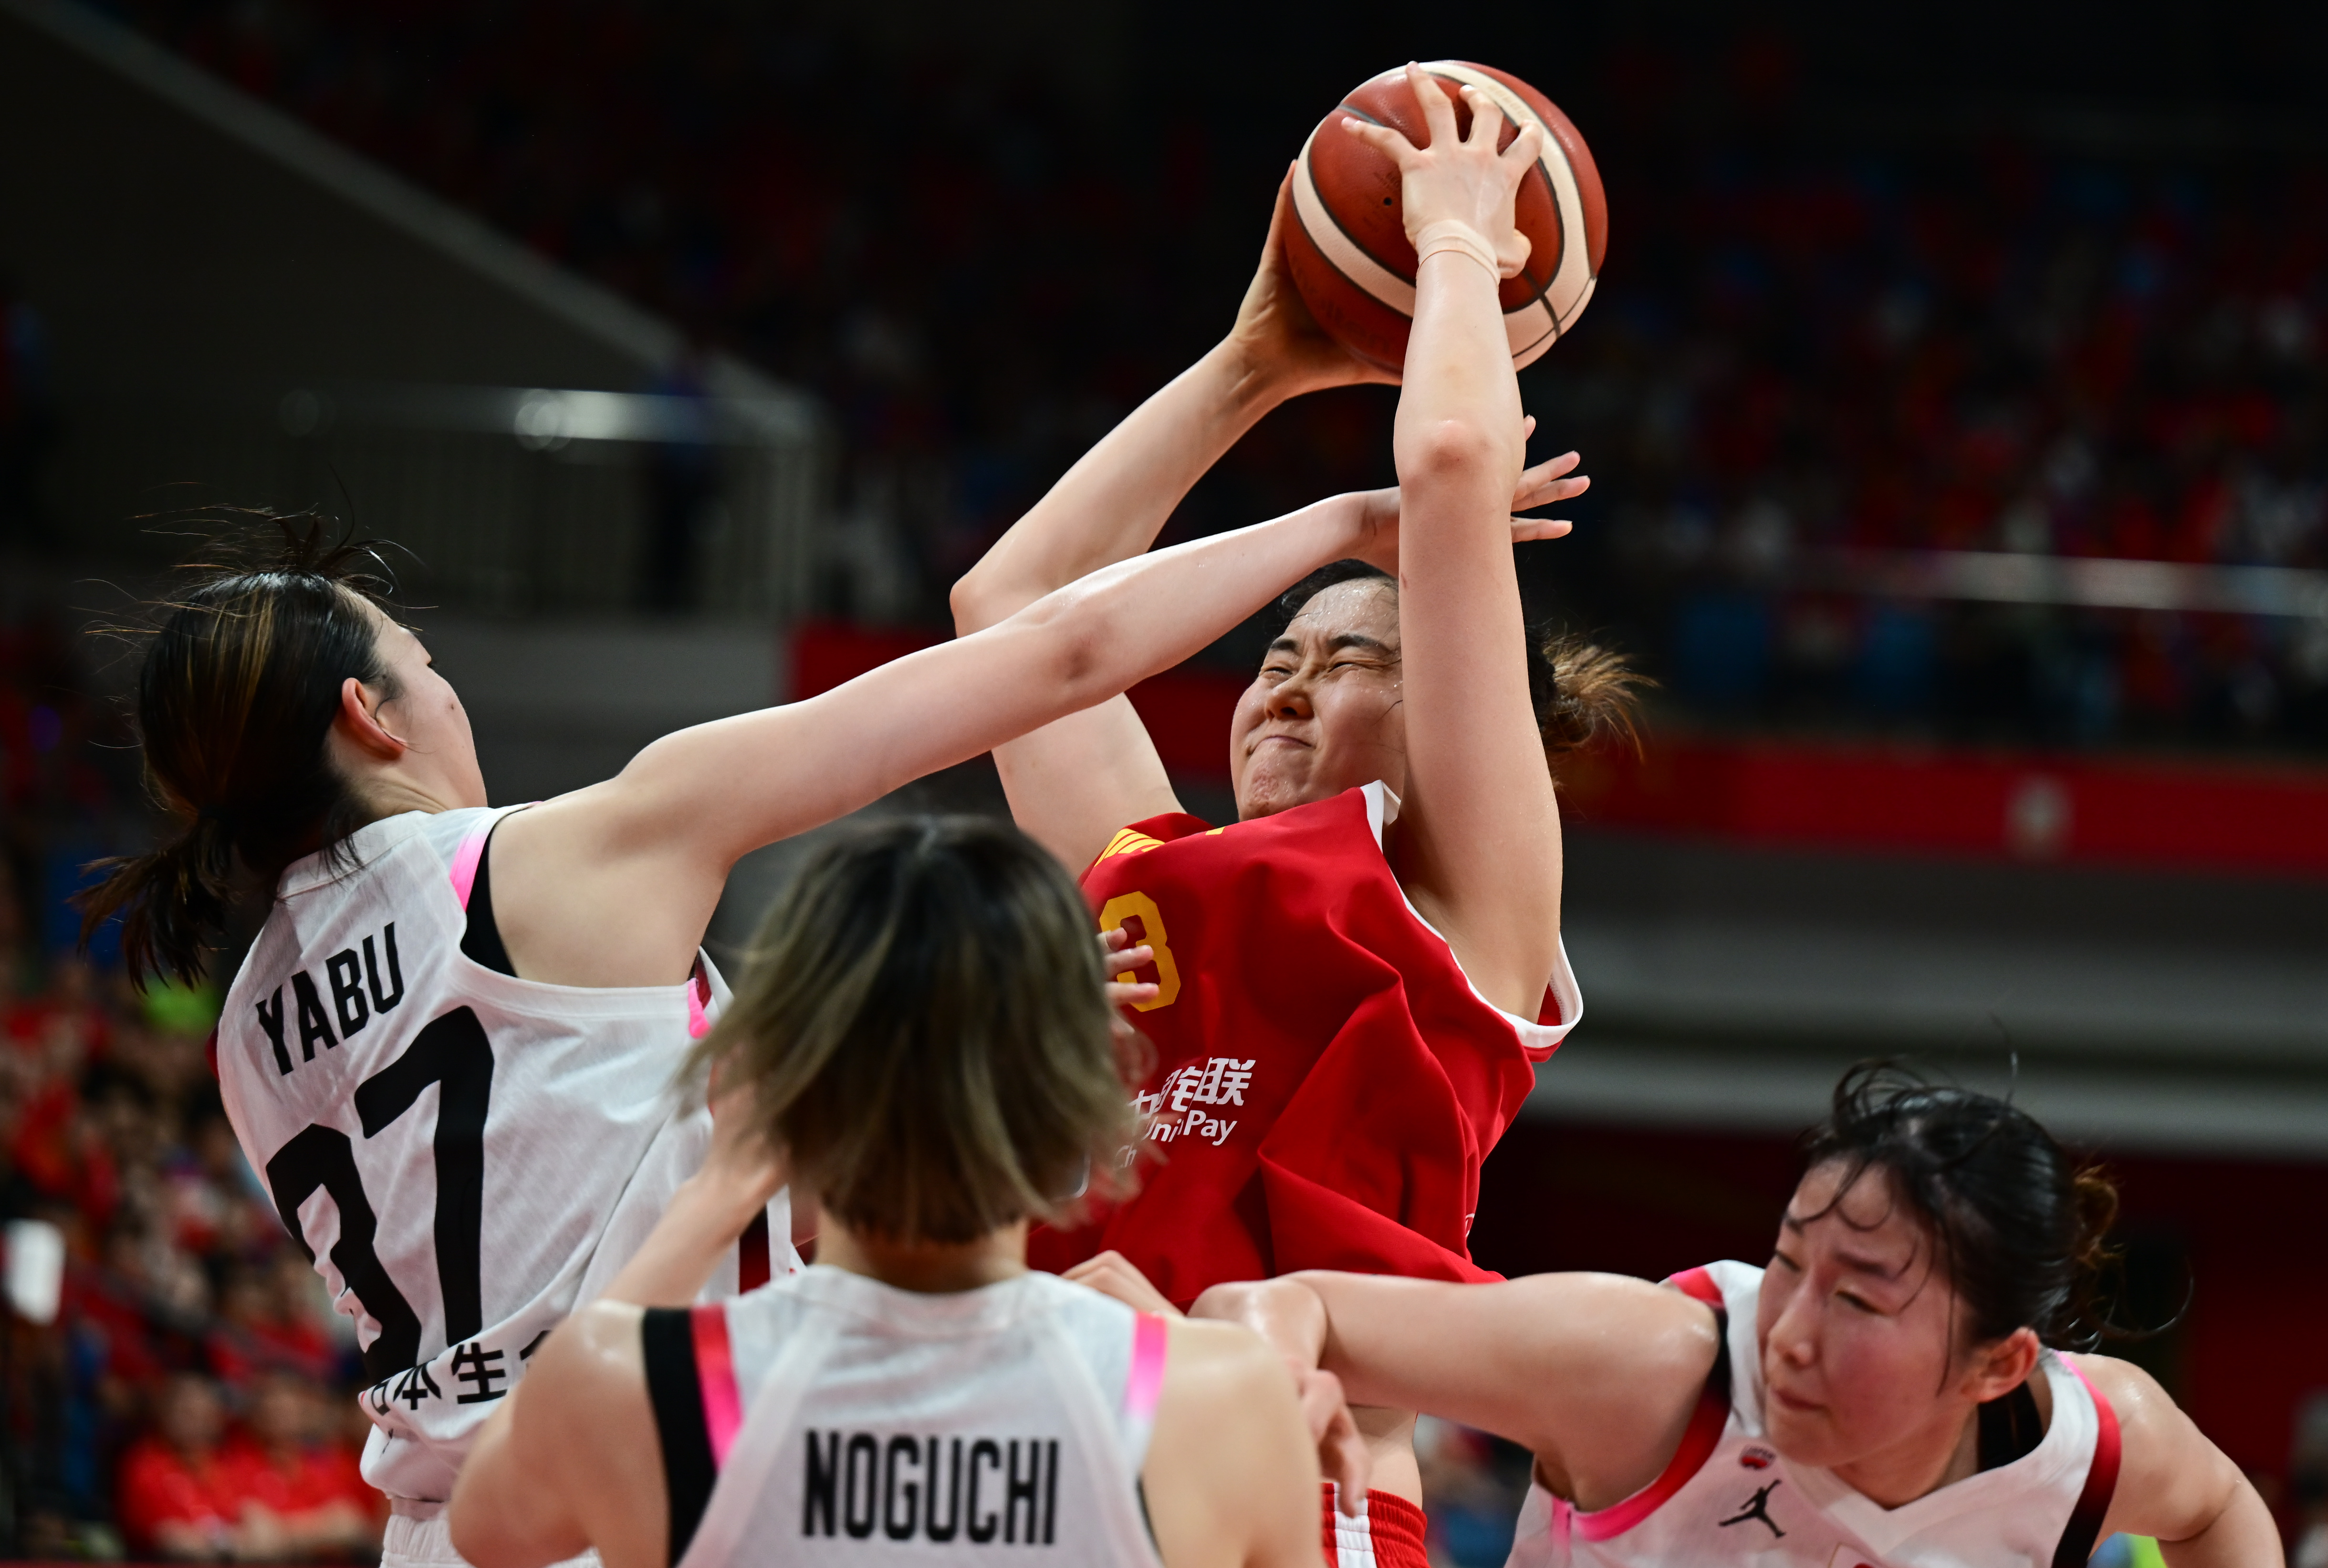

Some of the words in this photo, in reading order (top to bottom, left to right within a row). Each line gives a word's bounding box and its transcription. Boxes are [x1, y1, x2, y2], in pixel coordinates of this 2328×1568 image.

[255, 921, 405, 1076] YABU
[266, 1005, 495, 1382] 37
[371, 1330, 551, 1416] 日本生
[803, 1429, 1059, 1545] NOGUCHI
